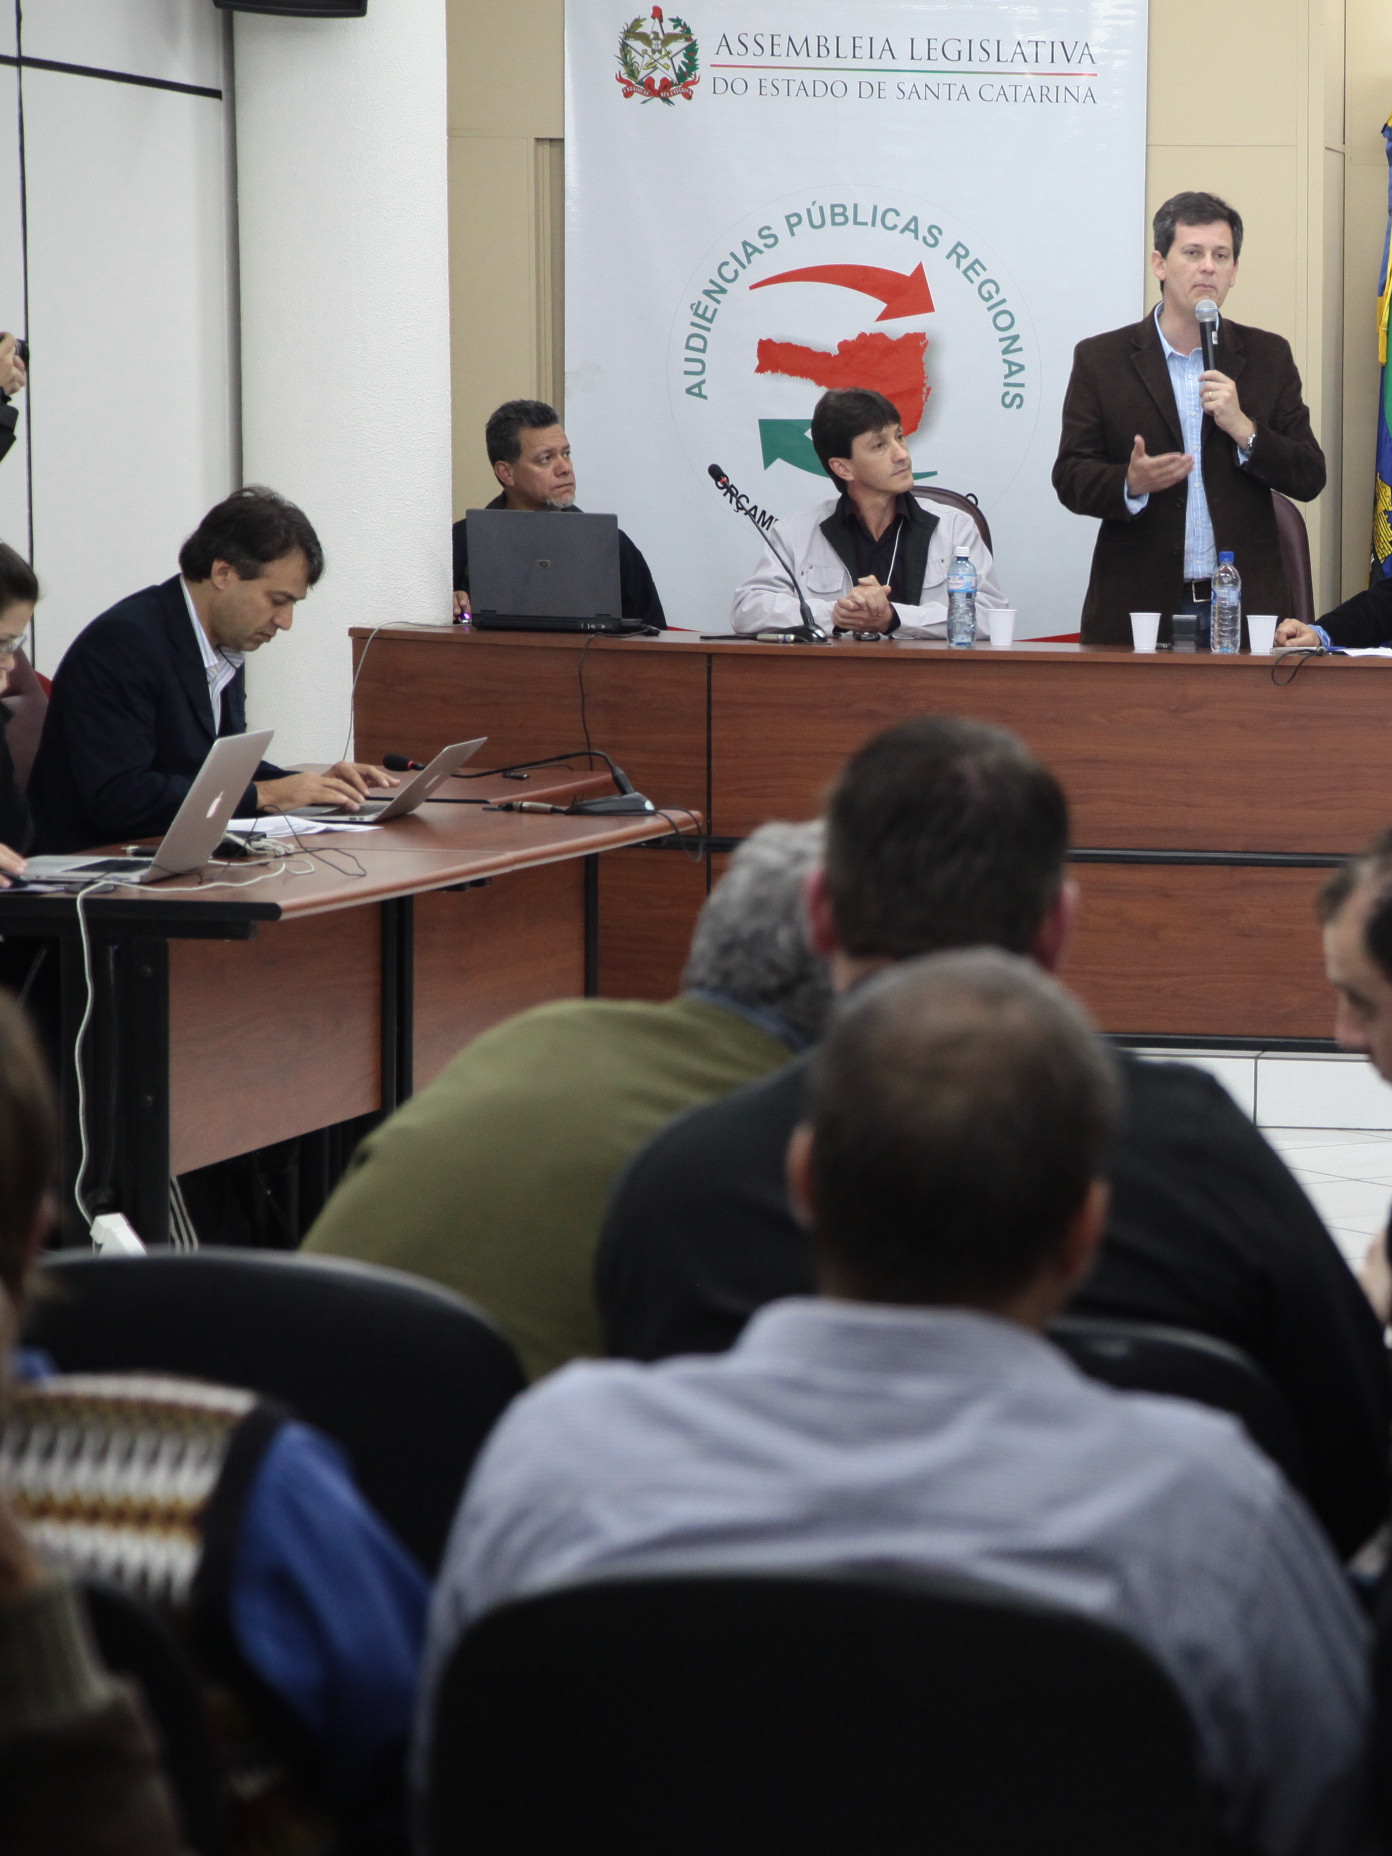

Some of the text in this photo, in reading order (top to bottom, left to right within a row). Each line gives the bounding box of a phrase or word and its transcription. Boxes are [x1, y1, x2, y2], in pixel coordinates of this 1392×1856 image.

[714, 32, 1098, 65] ASSEMBLEIA LEGISLATIVA
[711, 76, 1098, 105] DO ESTADO DE SANTA CATARINA
[683, 200, 1026, 410] AUDIÊNCIAS PÚBLICAS REGIONAIS
